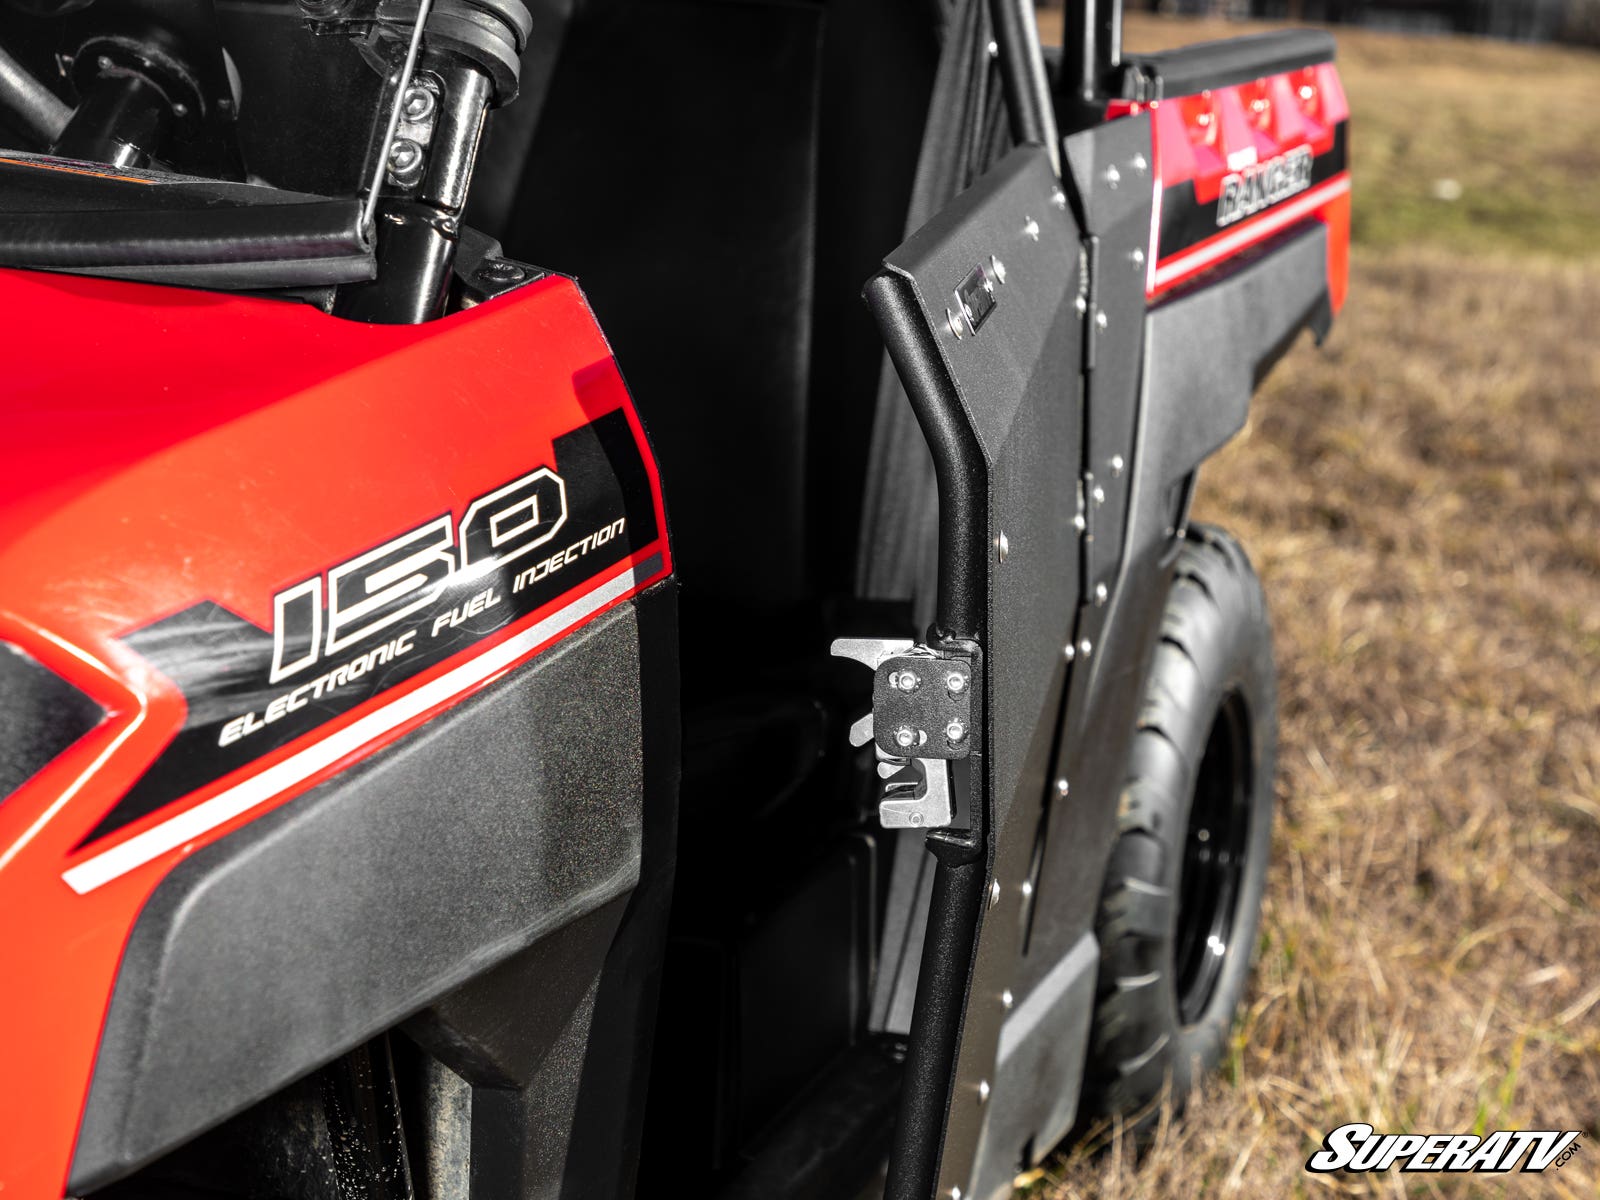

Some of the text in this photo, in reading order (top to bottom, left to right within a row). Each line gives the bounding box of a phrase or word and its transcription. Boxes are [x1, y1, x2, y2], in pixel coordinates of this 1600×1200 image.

[1216, 144, 1314, 227] RANGER
[218, 517, 626, 747] ELECTRONIC FUEL INJECTION
[269, 466, 569, 685] 150
